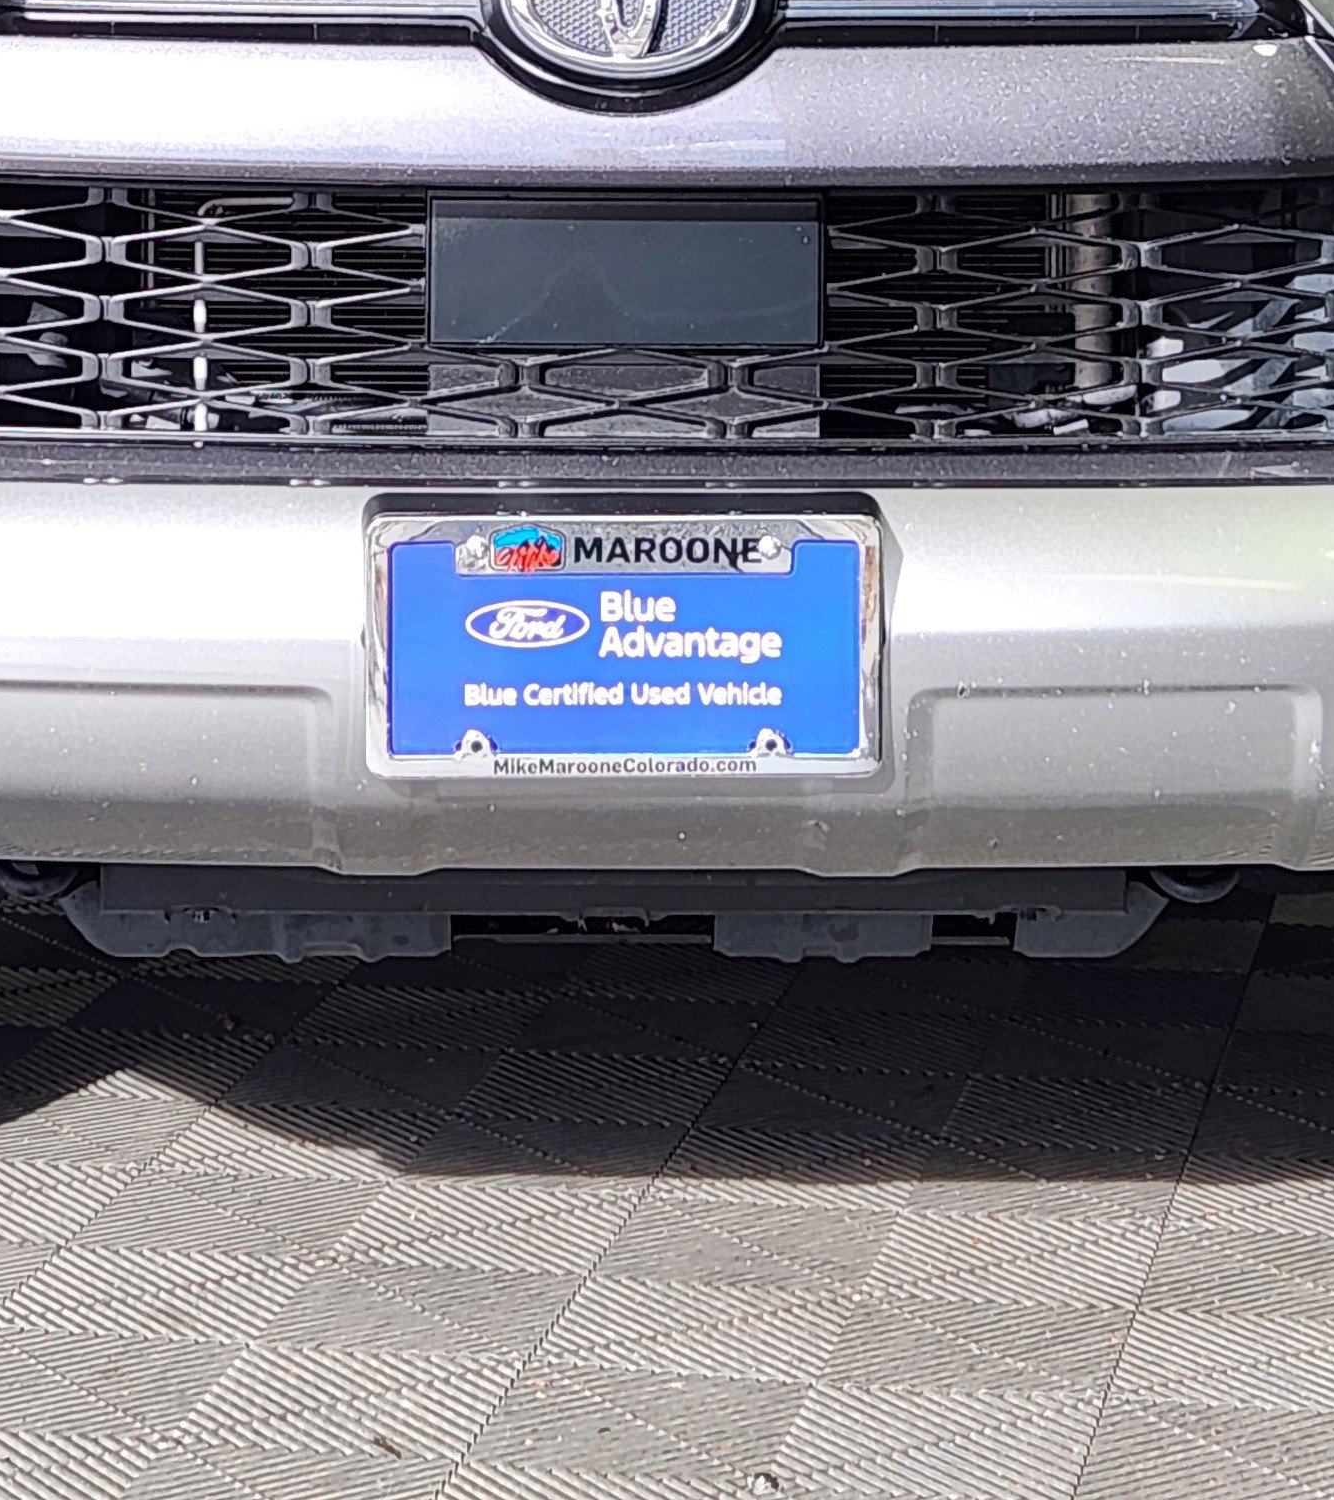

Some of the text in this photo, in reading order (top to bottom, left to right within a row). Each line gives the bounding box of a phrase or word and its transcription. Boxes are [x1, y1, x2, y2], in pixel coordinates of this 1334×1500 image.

[573, 536, 763, 564] MAROONE
[600, 589, 677, 623] Blue
[488, 606, 567, 640] Ford
[598, 625, 783, 664] Advantage
[464, 681, 783, 707] Blue Certified Used Vehicle
[493, 756, 757, 775] MikeMarooneColorado.com
